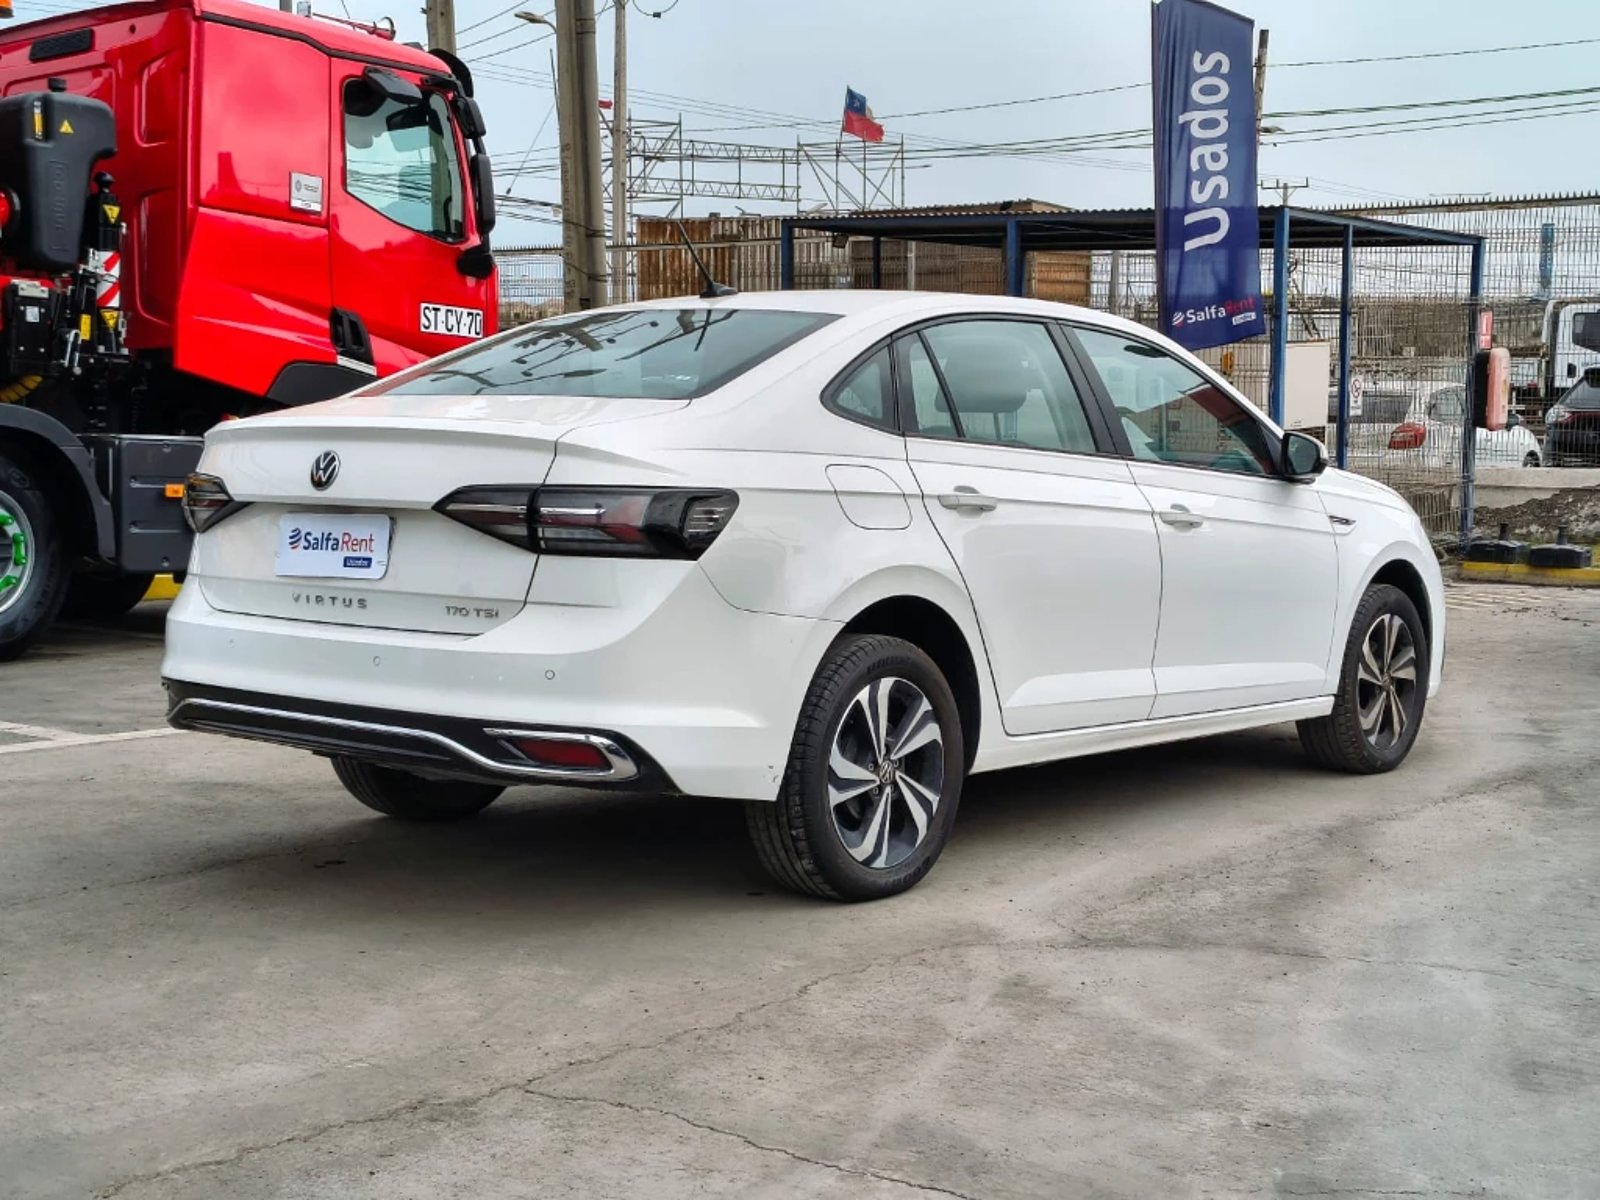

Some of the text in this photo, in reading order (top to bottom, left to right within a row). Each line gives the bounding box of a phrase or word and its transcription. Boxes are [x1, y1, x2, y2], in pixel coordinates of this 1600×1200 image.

[1179, 51, 1230, 252] Usados
[292, 593, 368, 609] VIRTUS
[445, 606, 469, 617] 170
